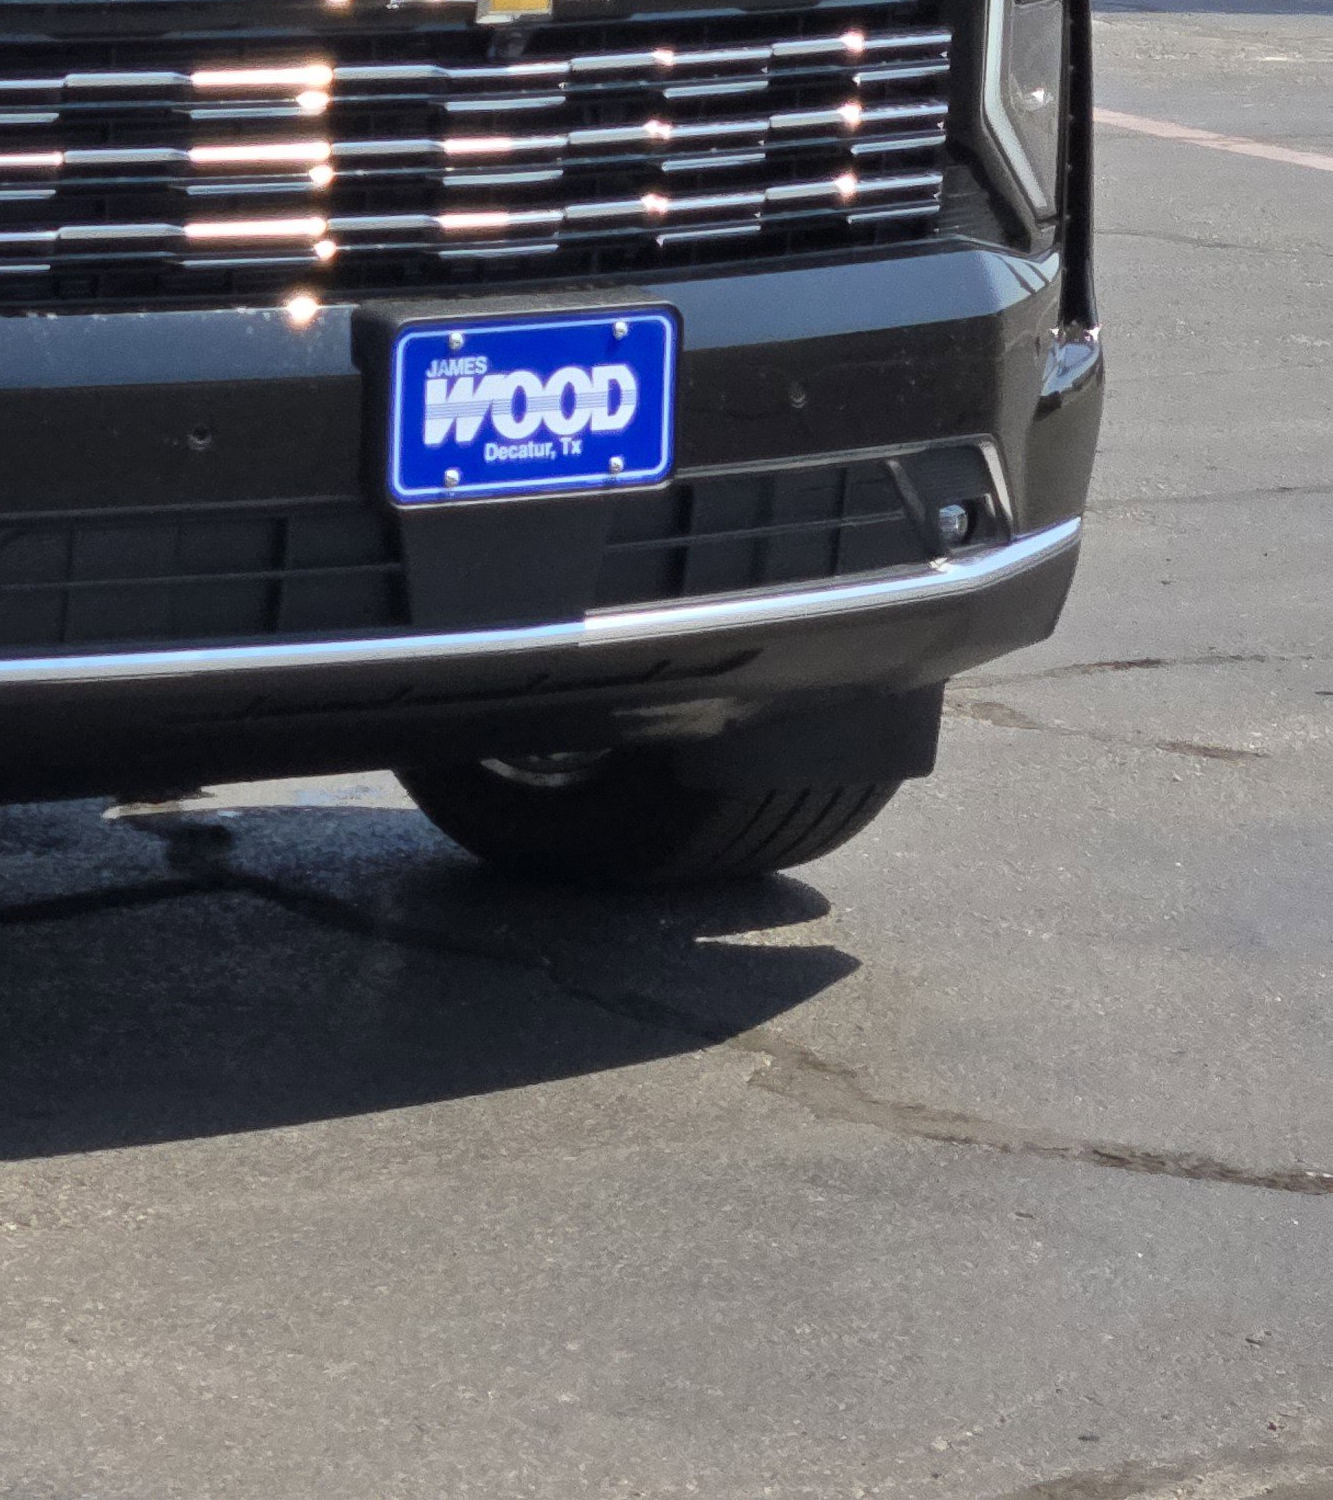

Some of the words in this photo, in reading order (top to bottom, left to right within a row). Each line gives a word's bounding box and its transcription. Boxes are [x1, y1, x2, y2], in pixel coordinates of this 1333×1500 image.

[425, 355, 489, 379] JAMES
[422, 363, 639, 447] WOOD
[483, 440, 557, 464] Decatur,
[560, 436, 582, 457] Tx
